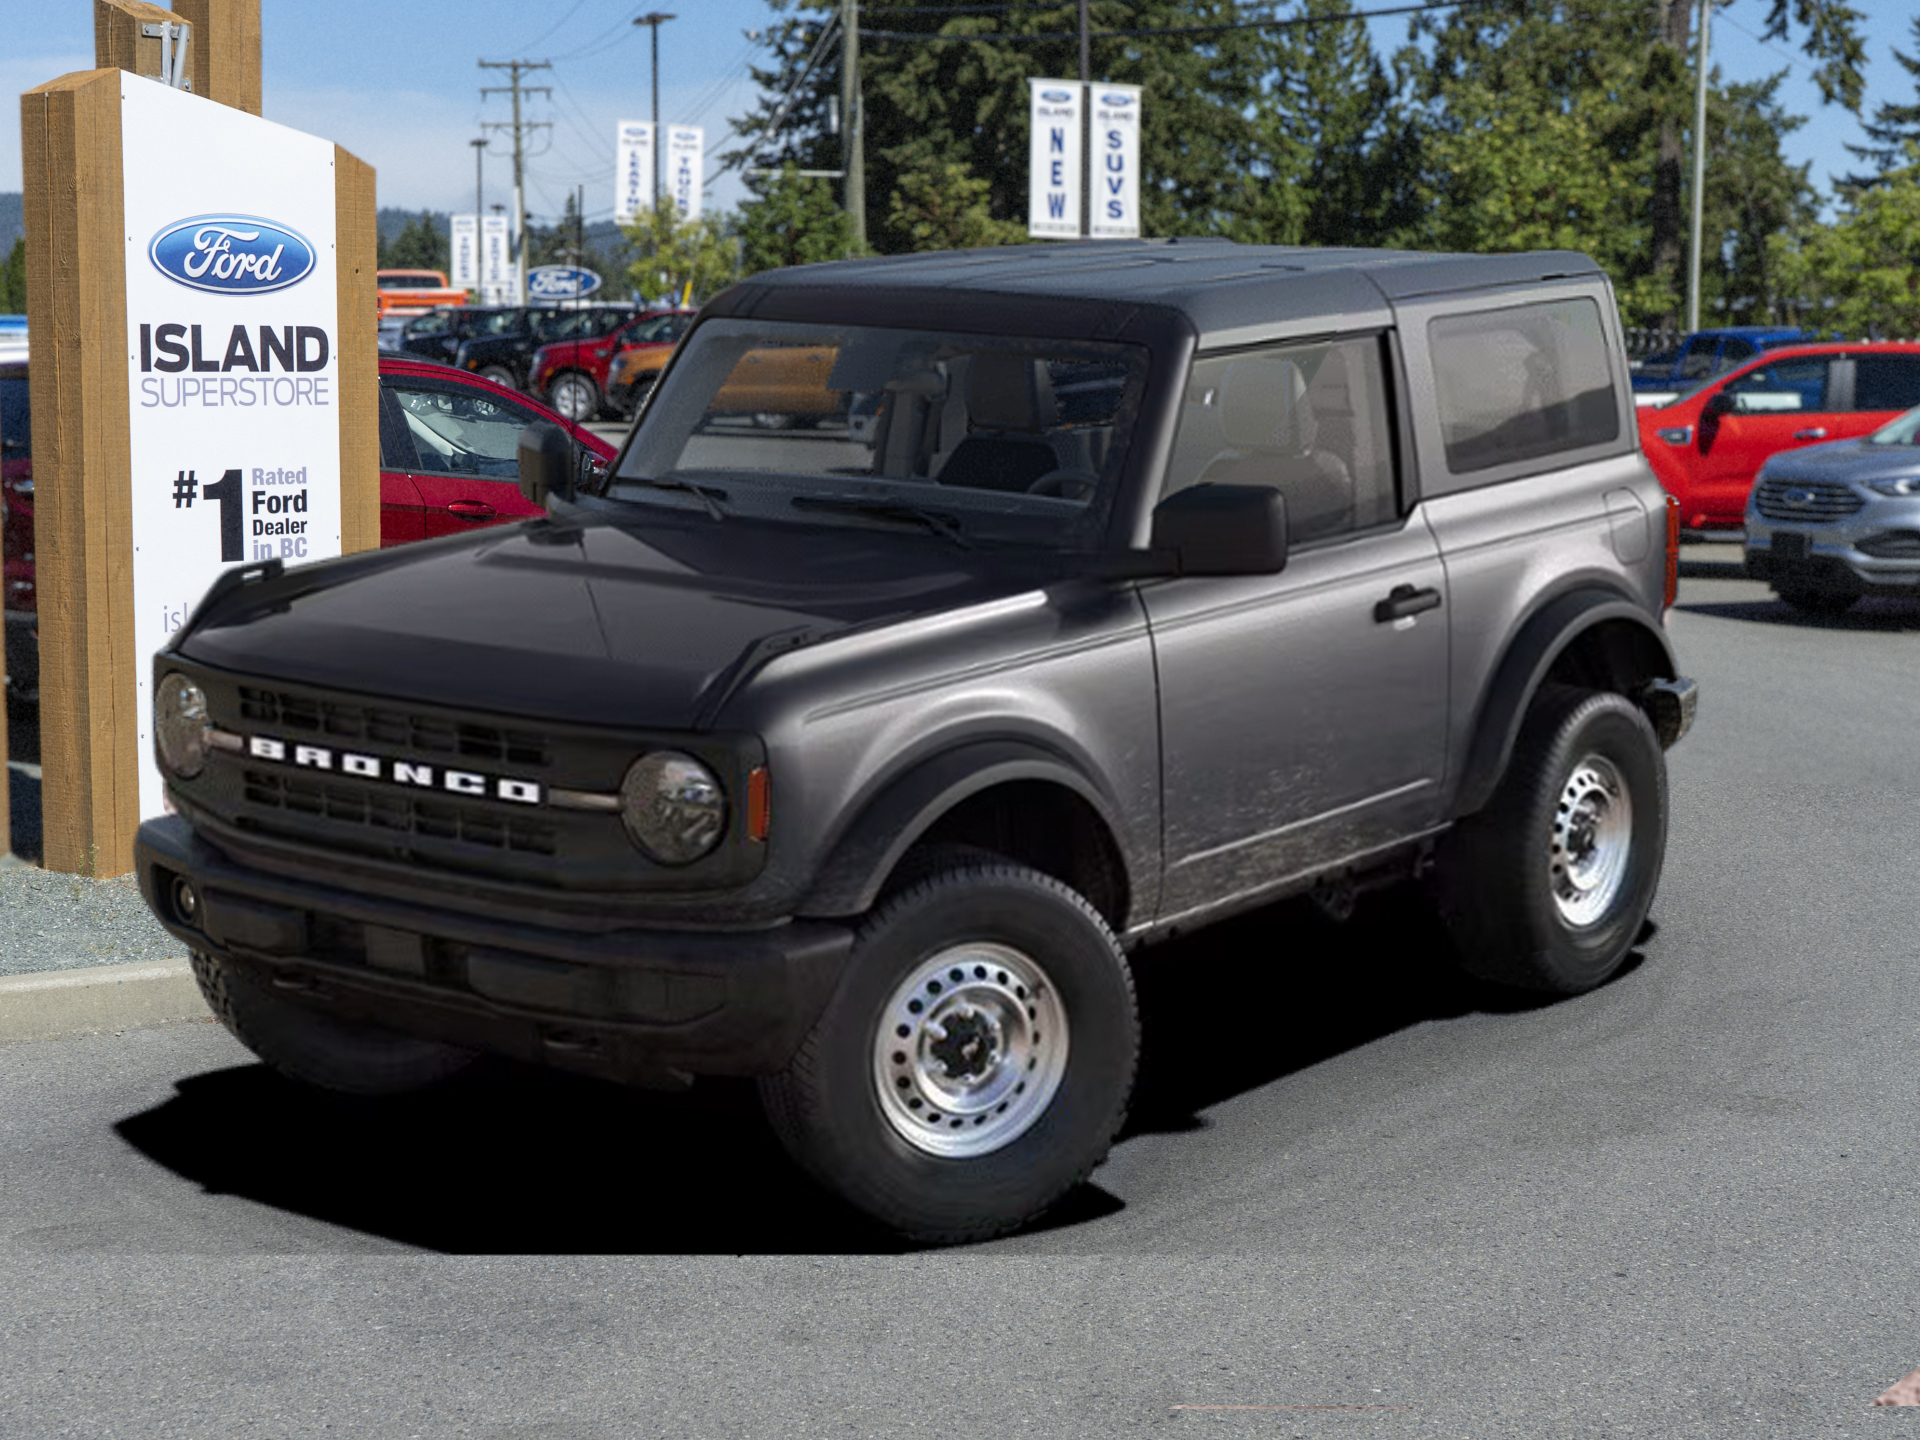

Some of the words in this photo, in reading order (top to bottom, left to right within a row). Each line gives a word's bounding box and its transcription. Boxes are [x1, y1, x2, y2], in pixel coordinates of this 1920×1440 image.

[1048, 126, 1066, 219] NEW
[1106, 129, 1124, 219] SUVS
[183, 225, 285, 283] Ford
[531, 268, 585, 294] Ford
[140, 323, 329, 373] ISLAND
[141, 377, 329, 408] SUPERSTORE
[252, 466, 307, 486] Rated
[172, 468, 245, 563] #1
[252, 488, 308, 514] Ford
[252, 518, 308, 536] Dealer
[253, 539, 273, 560] in
[280, 536, 308, 559] BC
[249, 736, 541, 804] BRONCO
